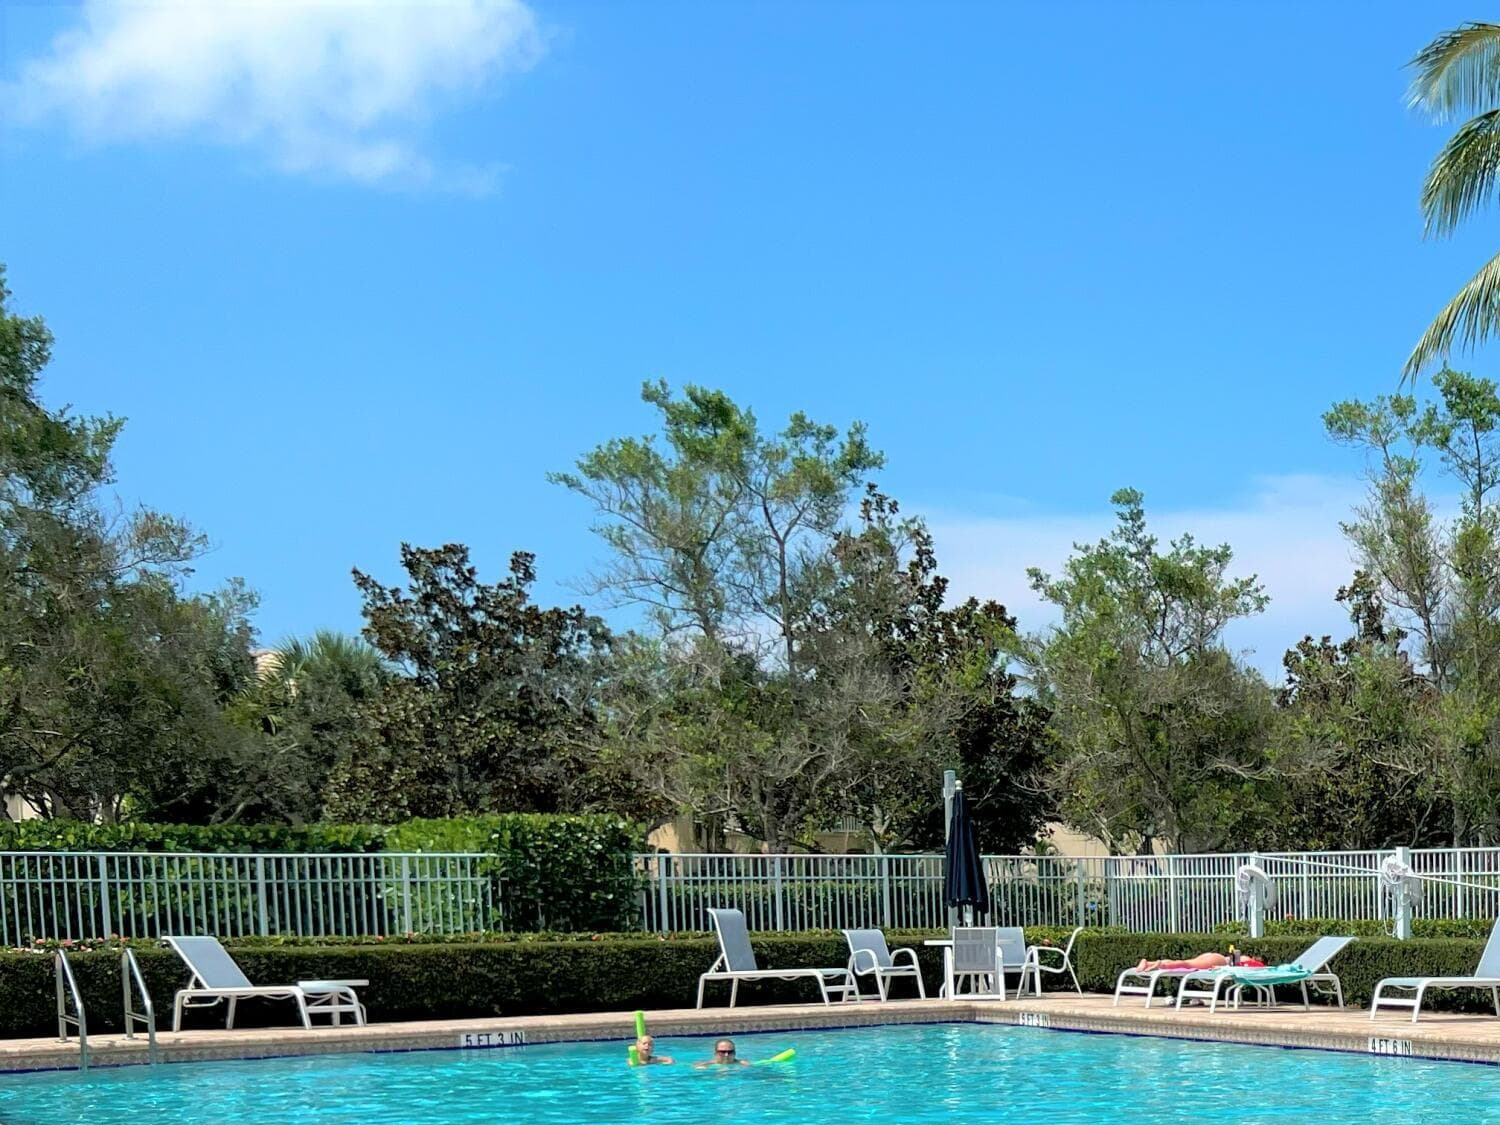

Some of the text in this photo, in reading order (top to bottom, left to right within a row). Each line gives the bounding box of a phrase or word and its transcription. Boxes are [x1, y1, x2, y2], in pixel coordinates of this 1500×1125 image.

[465, 1031, 523, 1047] 5 FT 3 IN
[1371, 1038, 1411, 1055] 4 FT 6 IN
